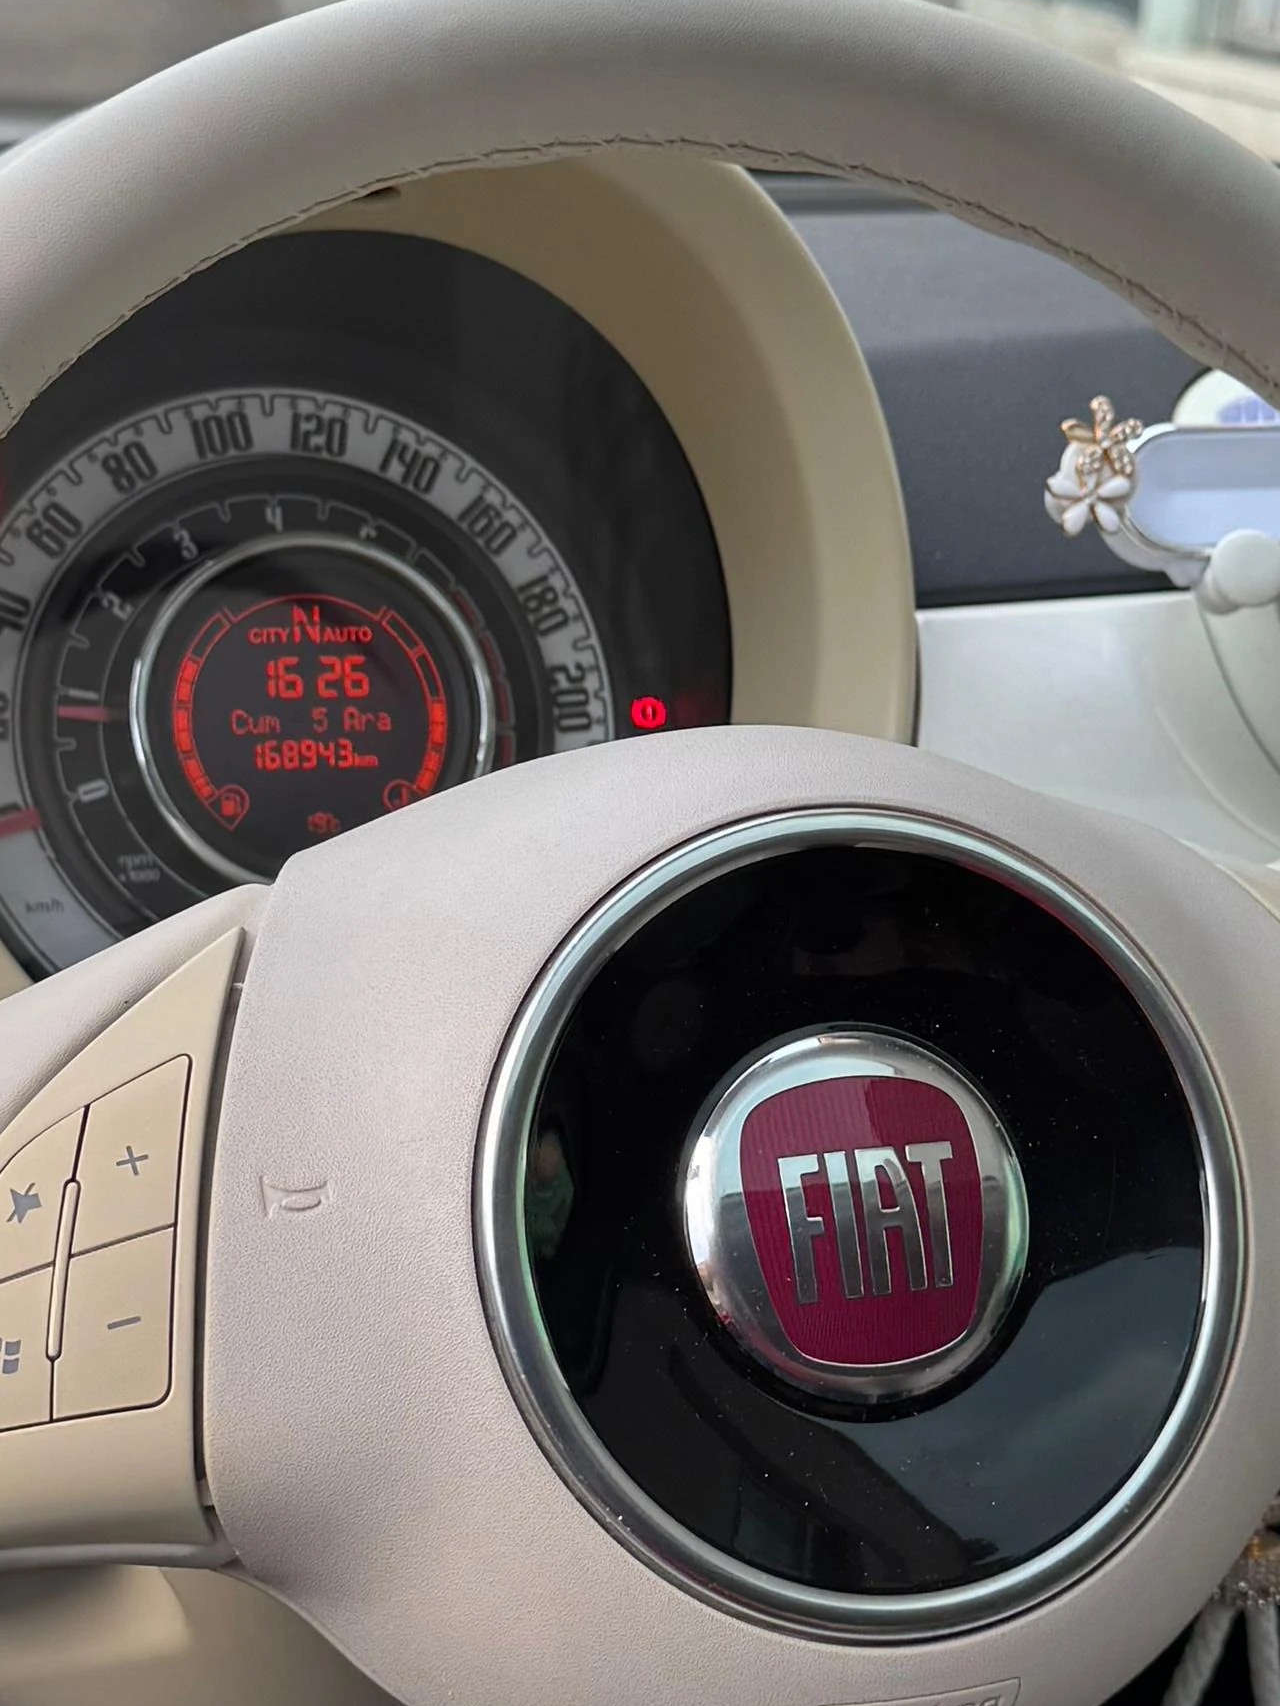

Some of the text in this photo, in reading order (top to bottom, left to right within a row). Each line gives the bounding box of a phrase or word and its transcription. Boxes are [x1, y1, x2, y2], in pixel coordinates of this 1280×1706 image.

[189, 411, 253, 460] 100
[290, 410, 348, 458] 120
[101, 441, 158, 493] 80
[379, 437, 443, 493] 140
[25, 501, 84, 559] 60
[173, 527, 199, 560] 3
[458, 492, 518, 556] 160
[101, 591, 134, 621] 2
[248, 605, 373, 644] CITY N AUTO
[517, 574, 570, 638] 180
[231, 706, 392, 735] Cum 5 Ara
[549, 663, 593, 733] 200
[77, 779, 110, 804] 0
[26, 899, 66, 915] km/h
[777, 1140, 954, 1305] FIAT
